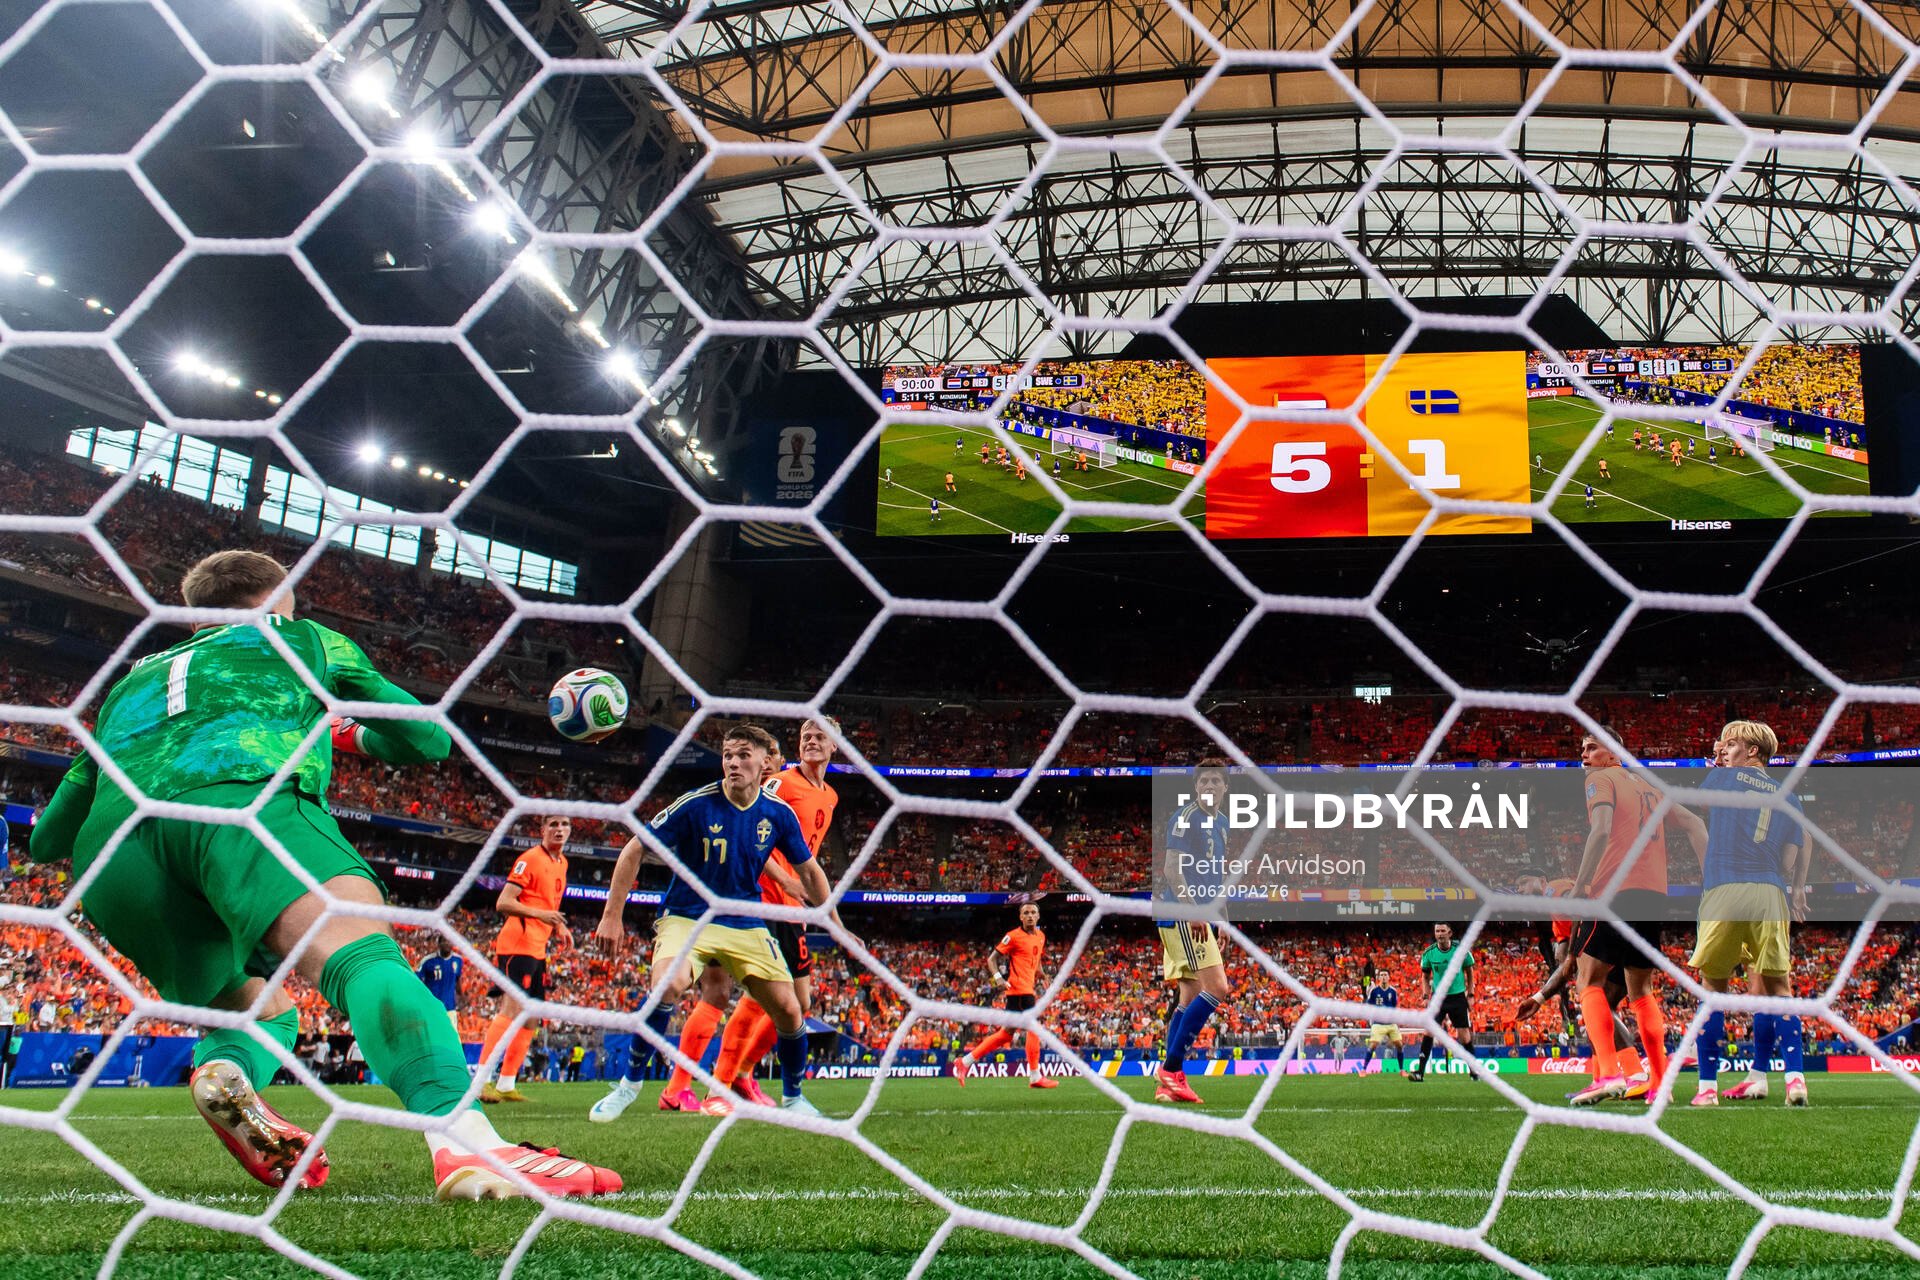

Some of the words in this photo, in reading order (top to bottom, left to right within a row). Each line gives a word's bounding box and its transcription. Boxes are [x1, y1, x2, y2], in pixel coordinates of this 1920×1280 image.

[1545, 365, 1580, 375] 90:0
[1618, 363, 1635, 372] NED
[1643, 363, 1649, 372] 5
[1683, 361, 1702, 371] SWE
[901, 379, 935, 390] 90:00
[972, 377, 989, 388] NED
[995, 378, 1003, 388] 5
[1035, 376, 1053, 386] SWE
[1546, 378, 1565, 387] 5:11
[901, 393, 920, 401] 5:11
[923, 392, 935, 401] +5
[1526, 390, 1558, 398] Lenovo
[1021, 421, 1036, 435] VISA
[1270, 441, 1332, 494] 5
[1408, 439, 1461, 489] 1
[776, 490, 814, 500] 2026
[1671, 519, 1732, 531] Hisense
[1011, 532, 1070, 544] Hisese
[163, 650, 195, 717] 1
[1891, 750, 1918, 758] WORLD
[905, 768, 931, 776] WORLD
[931, 768, 946, 776] CUP
[1736, 771, 1781, 793] BERGVAL
[329, 807, 372, 822] OUSTON
[702, 837, 728, 865] 17
[393, 866, 436, 880] HOUSTON
[566, 887, 583, 897] FIFA
[631, 893, 662, 904] 2026
[863, 893, 883, 902] FIFA
[883, 893, 916, 902] WORLD
[916, 894, 935, 903] CUP
[934, 894, 967, 903] 2026
[798, 936, 808, 960] 6
[1044, 1053, 1062, 1063] FIF
[815, 1065, 848, 1079] ADI
[849, 1066, 942, 1077] PREDTSTREET
[1014, 1062, 1083, 1077] AIWAYS
[1137, 1060, 1161, 1077] VI
[1409, 1058, 1500, 1074] aramo
[1541, 1057, 1587, 1074] Coca-Cola
